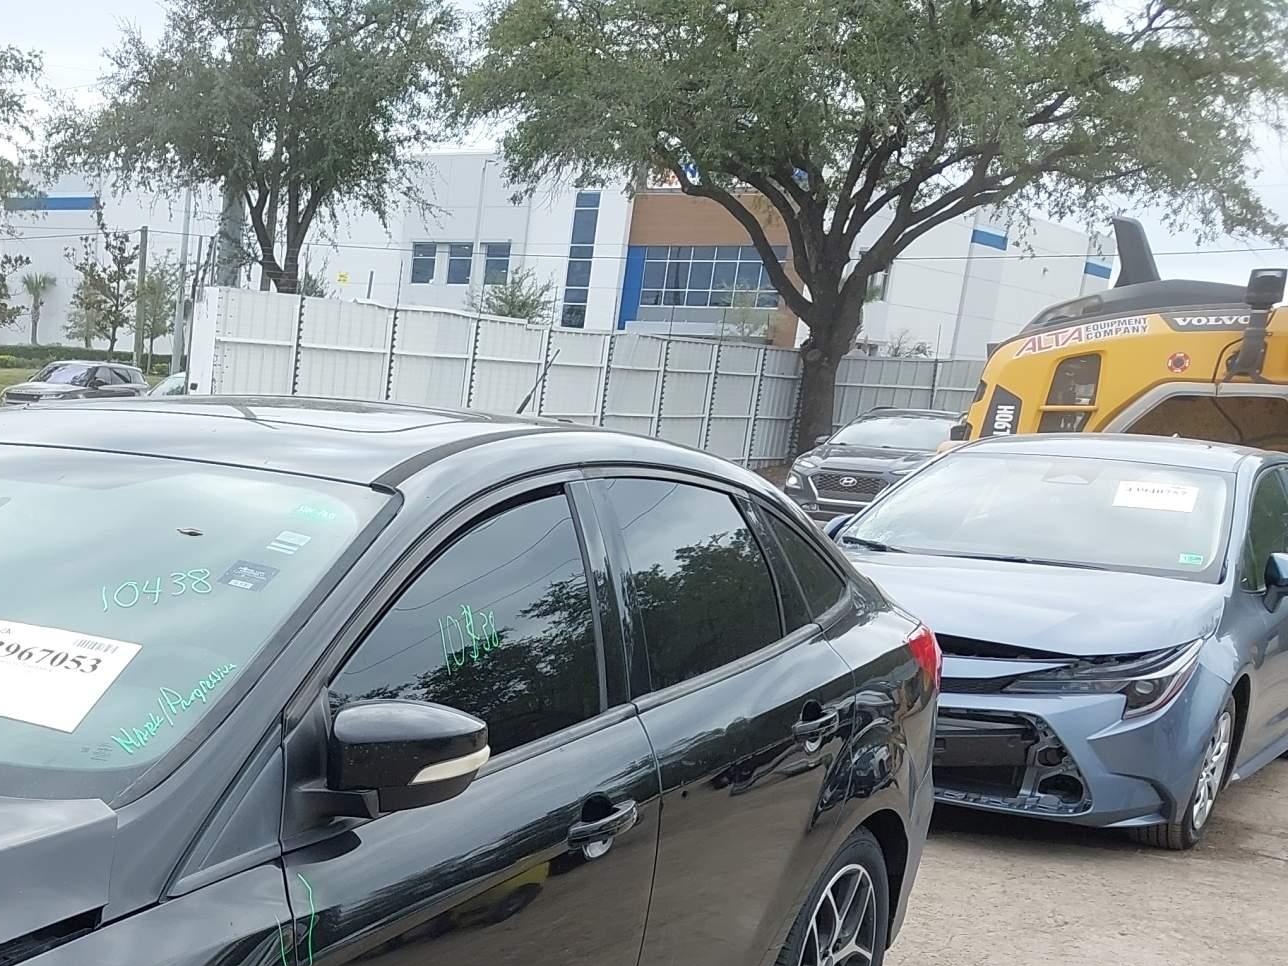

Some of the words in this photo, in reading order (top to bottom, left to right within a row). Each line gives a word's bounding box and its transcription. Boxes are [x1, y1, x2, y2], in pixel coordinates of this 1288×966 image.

[1086, 317, 1148, 333] EQUIPMENT
[1173, 315, 1251, 326] VOLVO
[1086, 325, 1149, 341] COMPANY
[1015, 327, 1084, 357] ALTA
[102, 568, 212, 612] 10438
